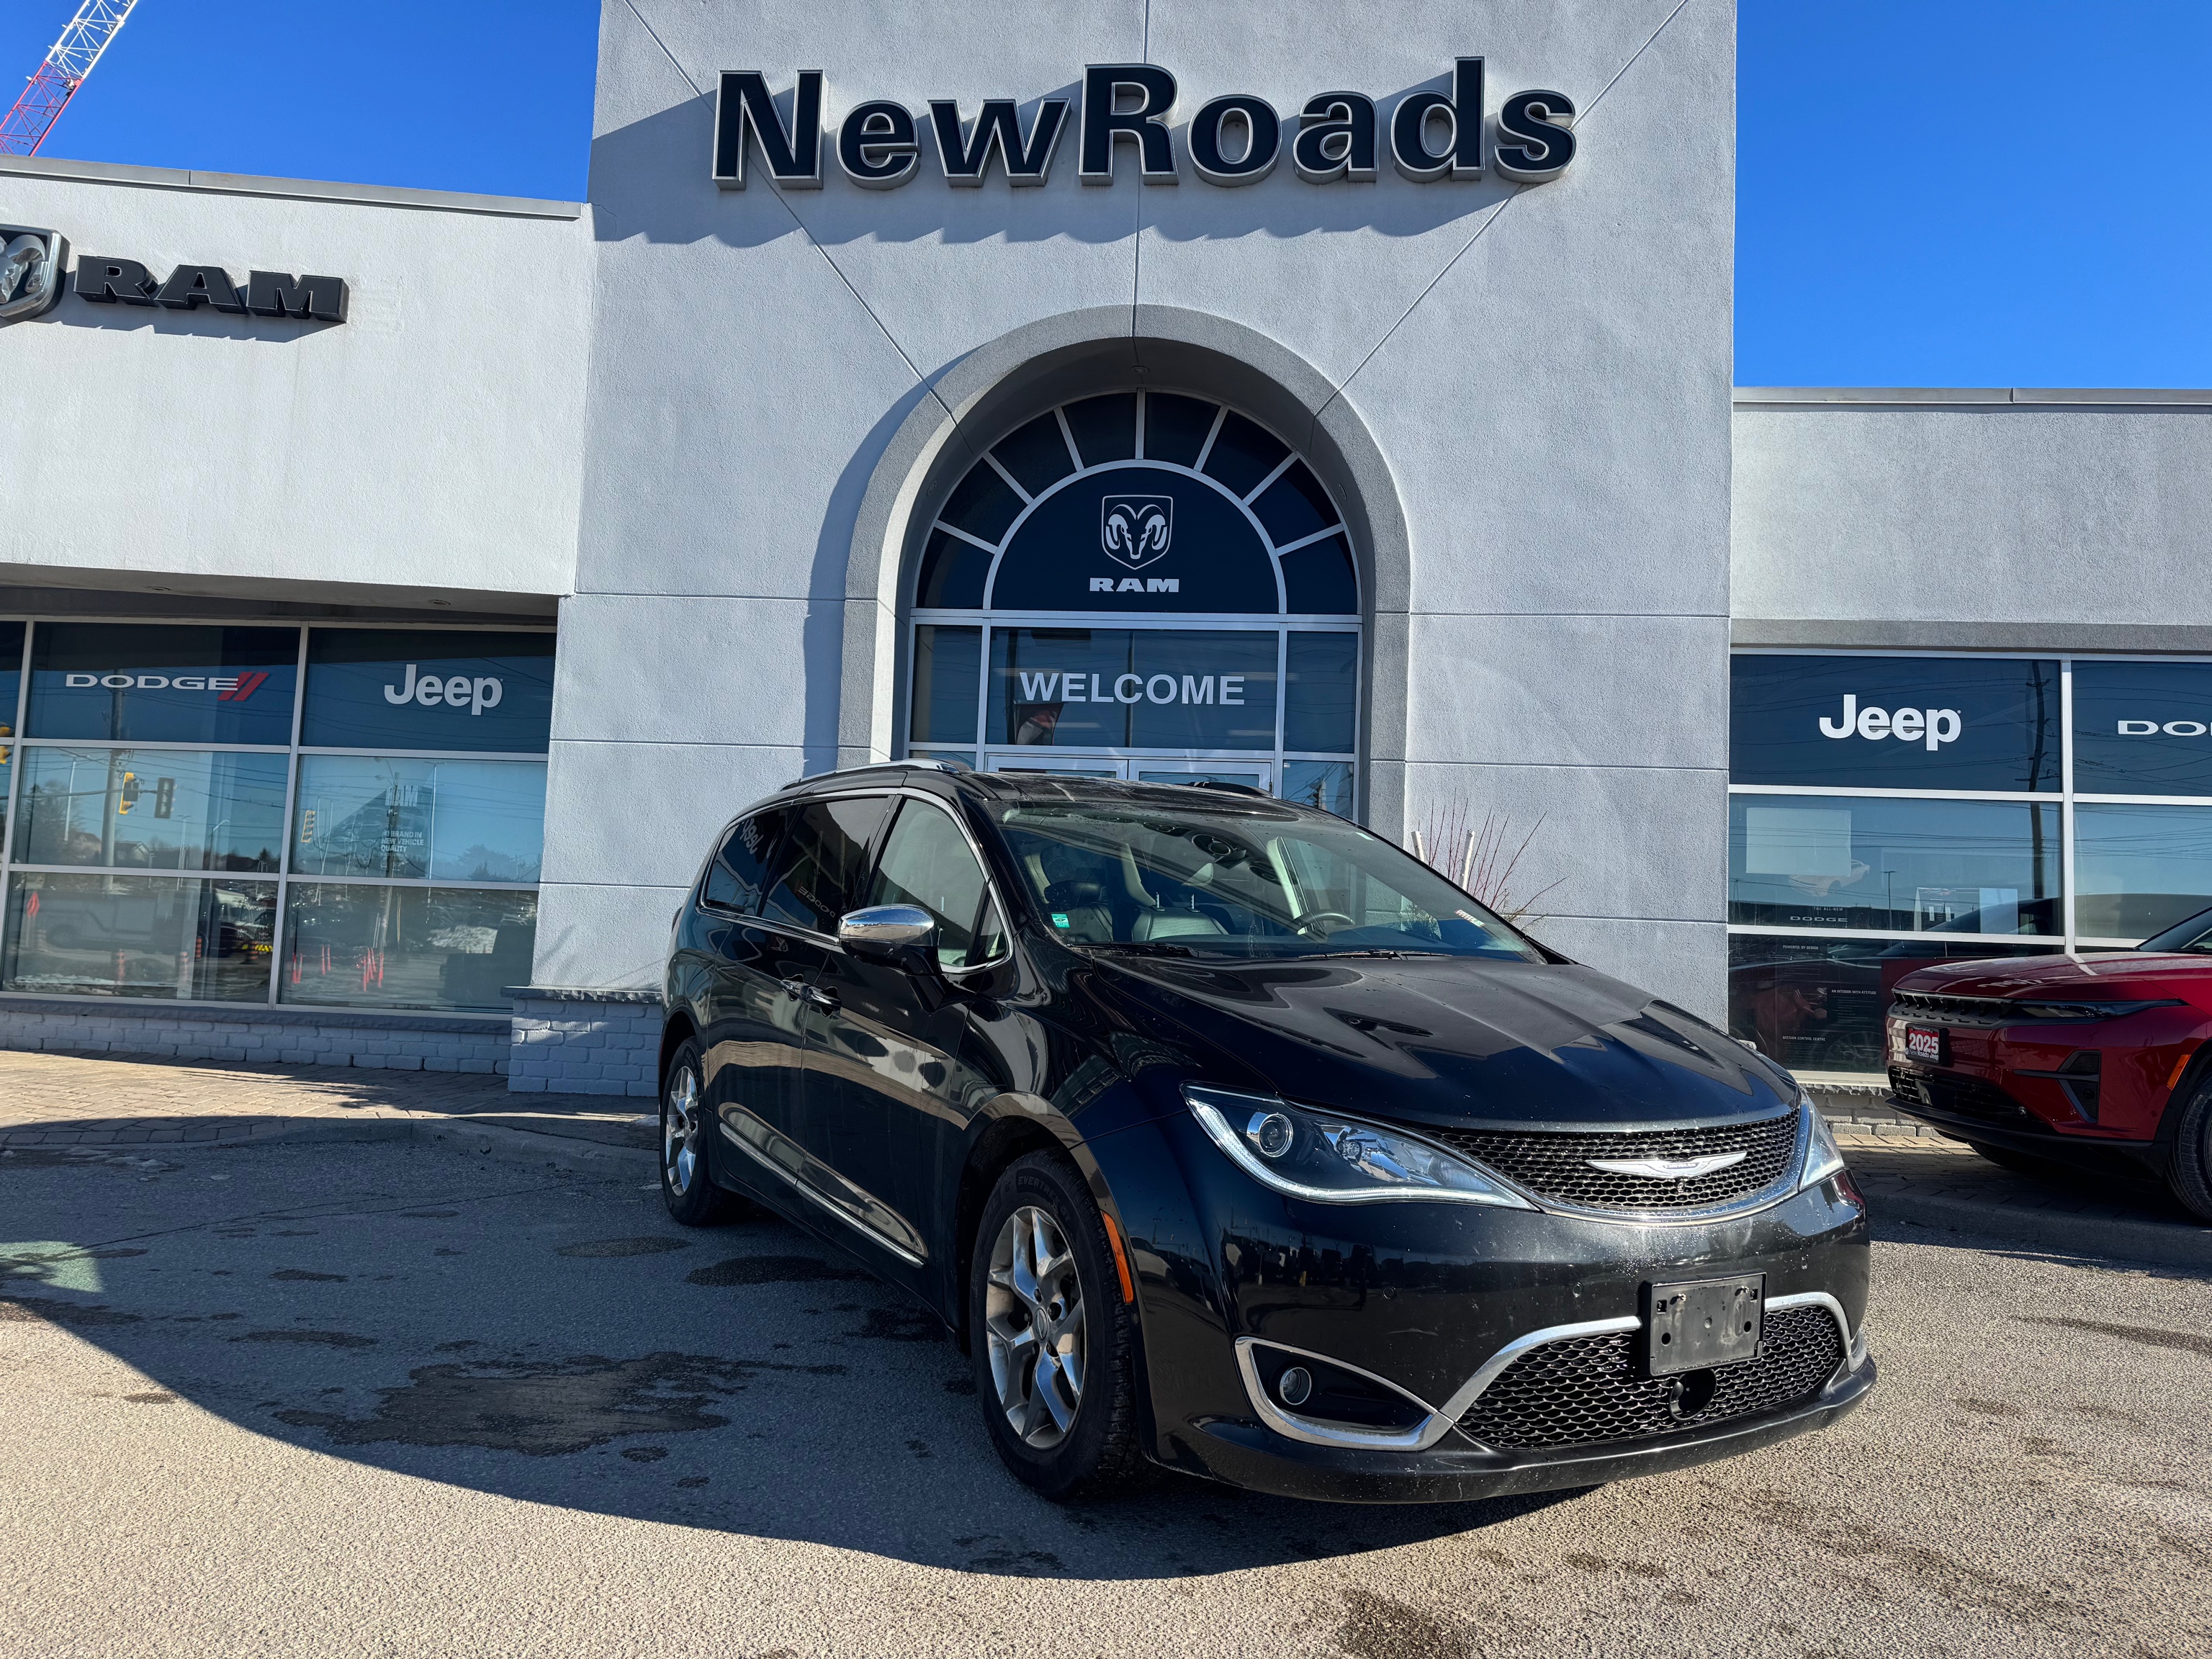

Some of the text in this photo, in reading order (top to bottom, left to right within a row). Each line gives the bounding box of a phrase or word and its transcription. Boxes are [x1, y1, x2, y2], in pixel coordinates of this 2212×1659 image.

[711, 55, 1576, 186] NewRoads
[73, 254, 349, 323] RAM
[1089, 577, 1179, 593] RAM
[66, 673, 238, 691] DODGE
[384, 664, 503, 716] Jeep
[1020, 672, 1245, 705] WELCOME
[1819, 694, 1961, 751] Jeep
[2118, 720, 2212, 737] DO
[380, 844, 408, 853] QUALITY
[1909, 1033, 1938, 1054] 2025
